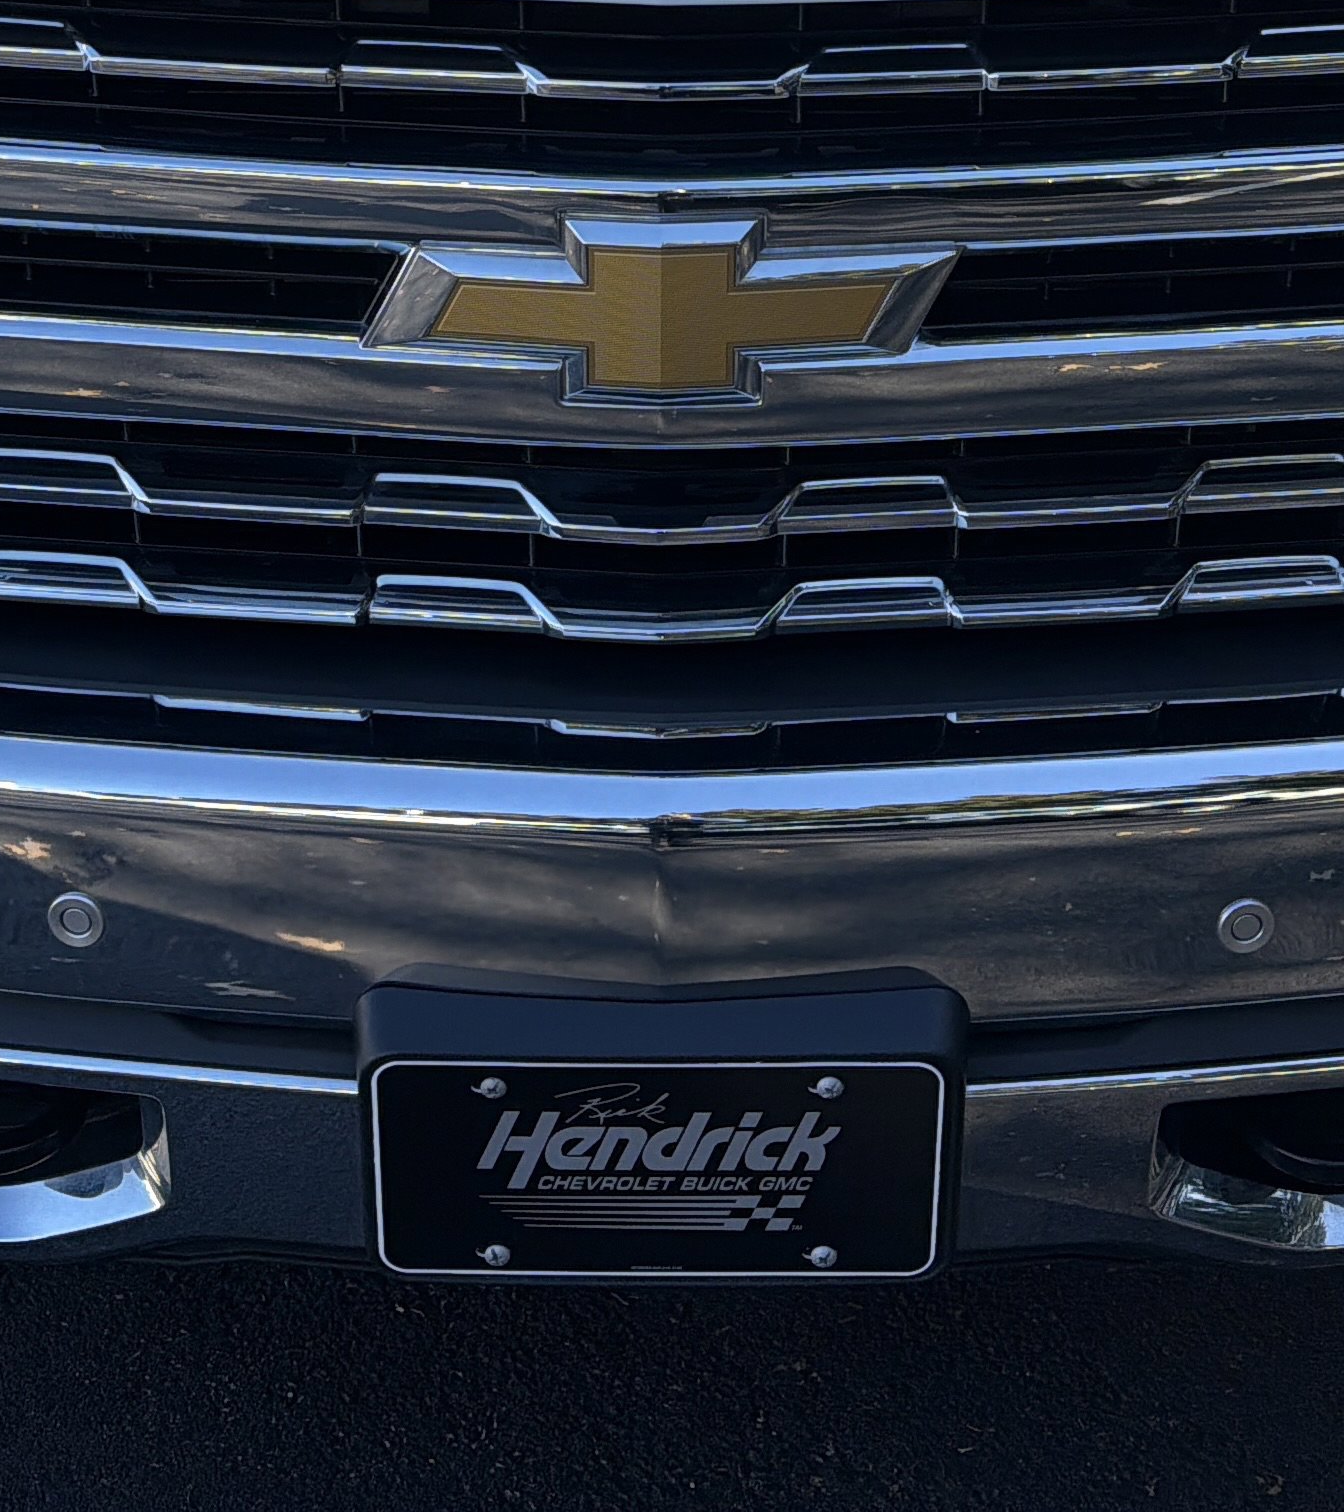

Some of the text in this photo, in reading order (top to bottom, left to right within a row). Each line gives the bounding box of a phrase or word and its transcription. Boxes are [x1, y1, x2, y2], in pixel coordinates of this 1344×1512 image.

[476, 1111, 842, 1189] Hendrick
[537, 1175, 813, 1191] CHEVROLET BUICK GMC
